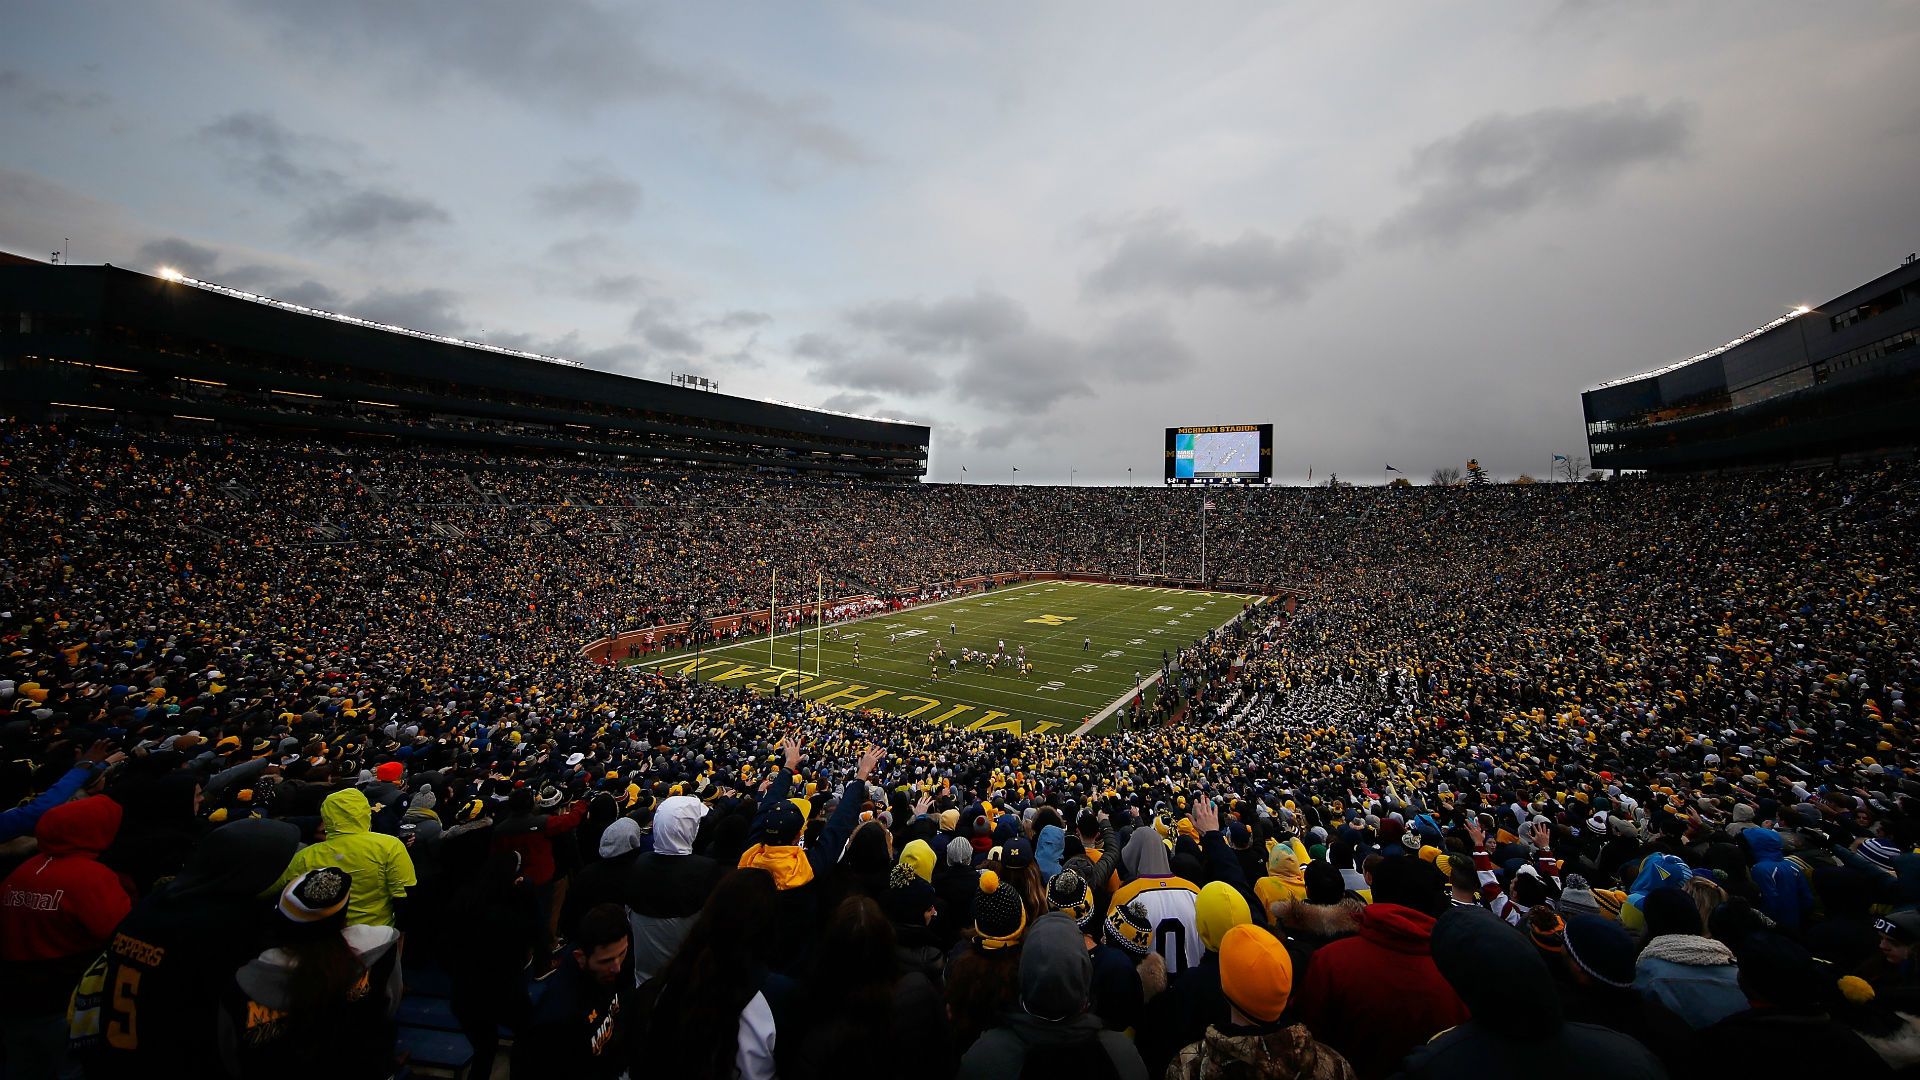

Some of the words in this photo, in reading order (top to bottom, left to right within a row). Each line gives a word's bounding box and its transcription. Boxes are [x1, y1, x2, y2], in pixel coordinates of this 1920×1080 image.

[1040, 680, 1066, 692] 10
[1010, 848, 1019, 856] M
[106, 964, 142, 1050] 5
